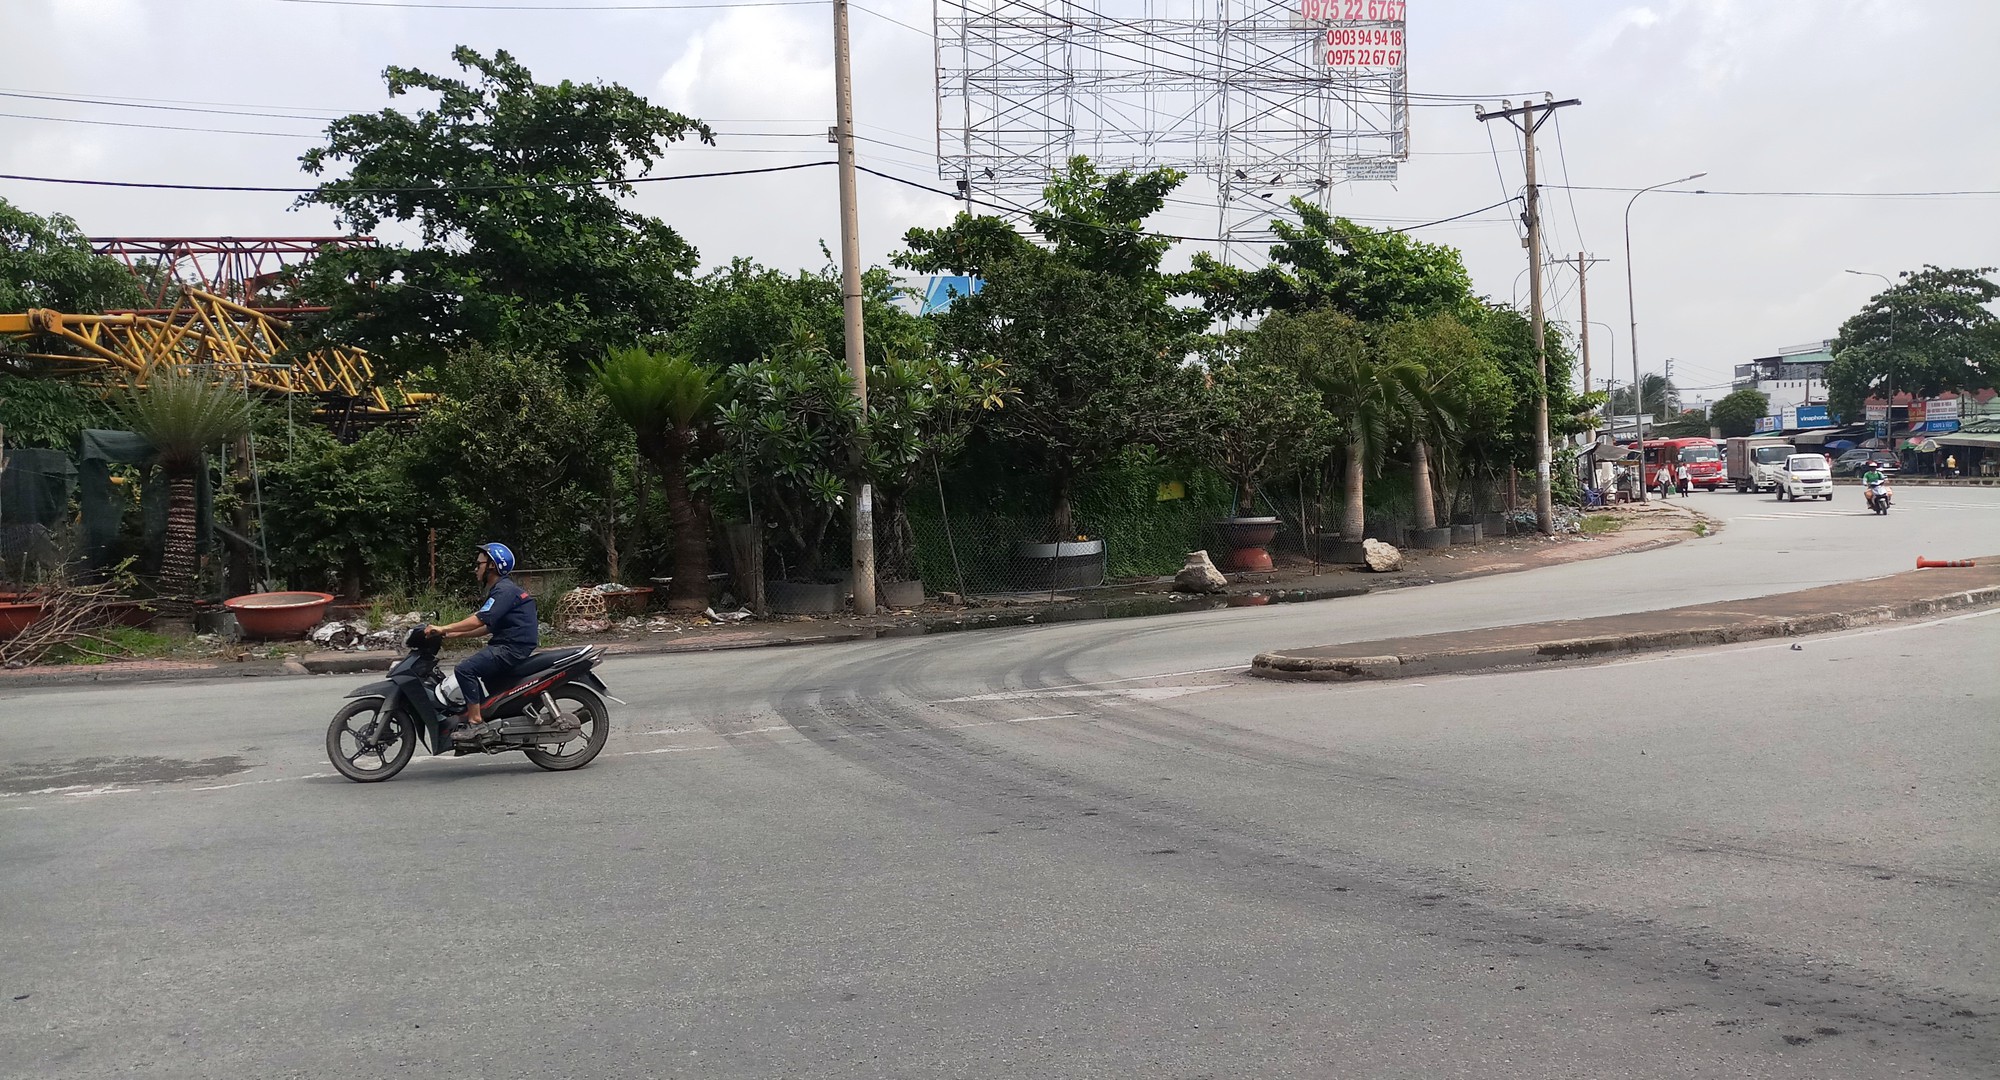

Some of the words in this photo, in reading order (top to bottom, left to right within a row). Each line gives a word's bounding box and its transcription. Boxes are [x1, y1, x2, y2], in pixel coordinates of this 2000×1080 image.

[1301, 0, 1339, 19] 0975
[1344, 0, 1363, 19] 22
[1368, 0, 1405, 21] 6767
[1327, 30, 1355, 45] 0903
[1358, 30, 1372, 45] 94
[1374, 30, 1388, 45] 94
[1390, 30, 1402, 45] 18
[1327, 50, 1355, 65] 0975
[1357, 50, 1370, 65] 22
[1372, 50, 1386, 65] 67
[1388, 50, 1402, 65] 67
